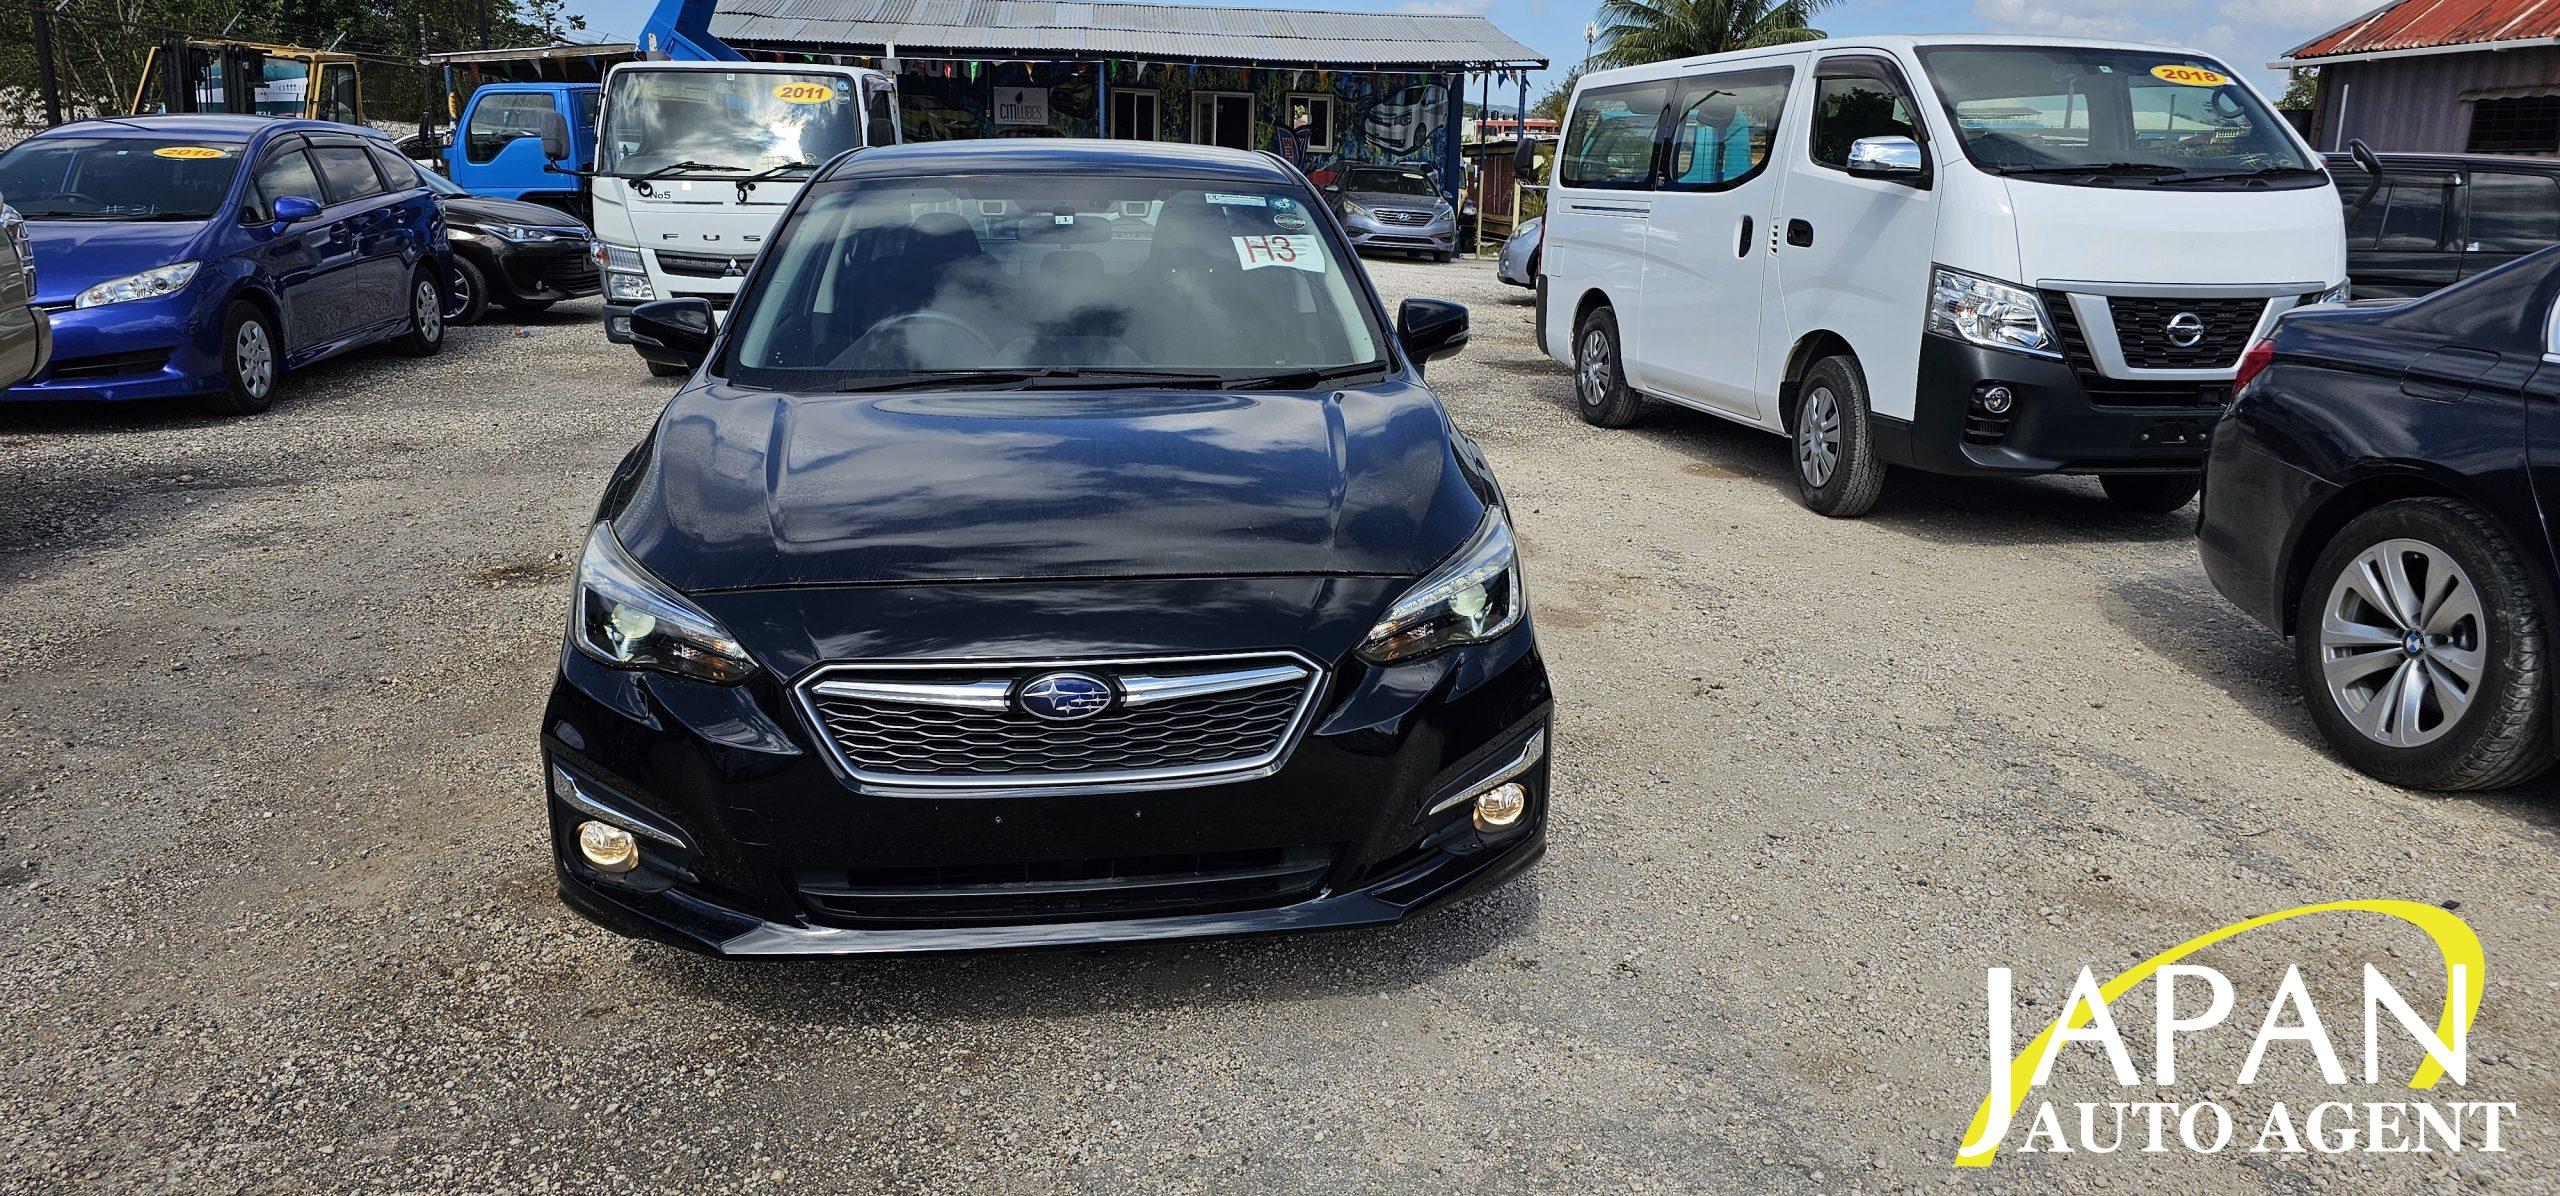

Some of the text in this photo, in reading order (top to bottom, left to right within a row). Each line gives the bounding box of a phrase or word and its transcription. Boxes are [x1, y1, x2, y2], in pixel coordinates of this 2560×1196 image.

[2162, 69, 2219, 82] 2018
[780, 87, 824, 99] 2011
[1241, 233, 1297, 263] H3
